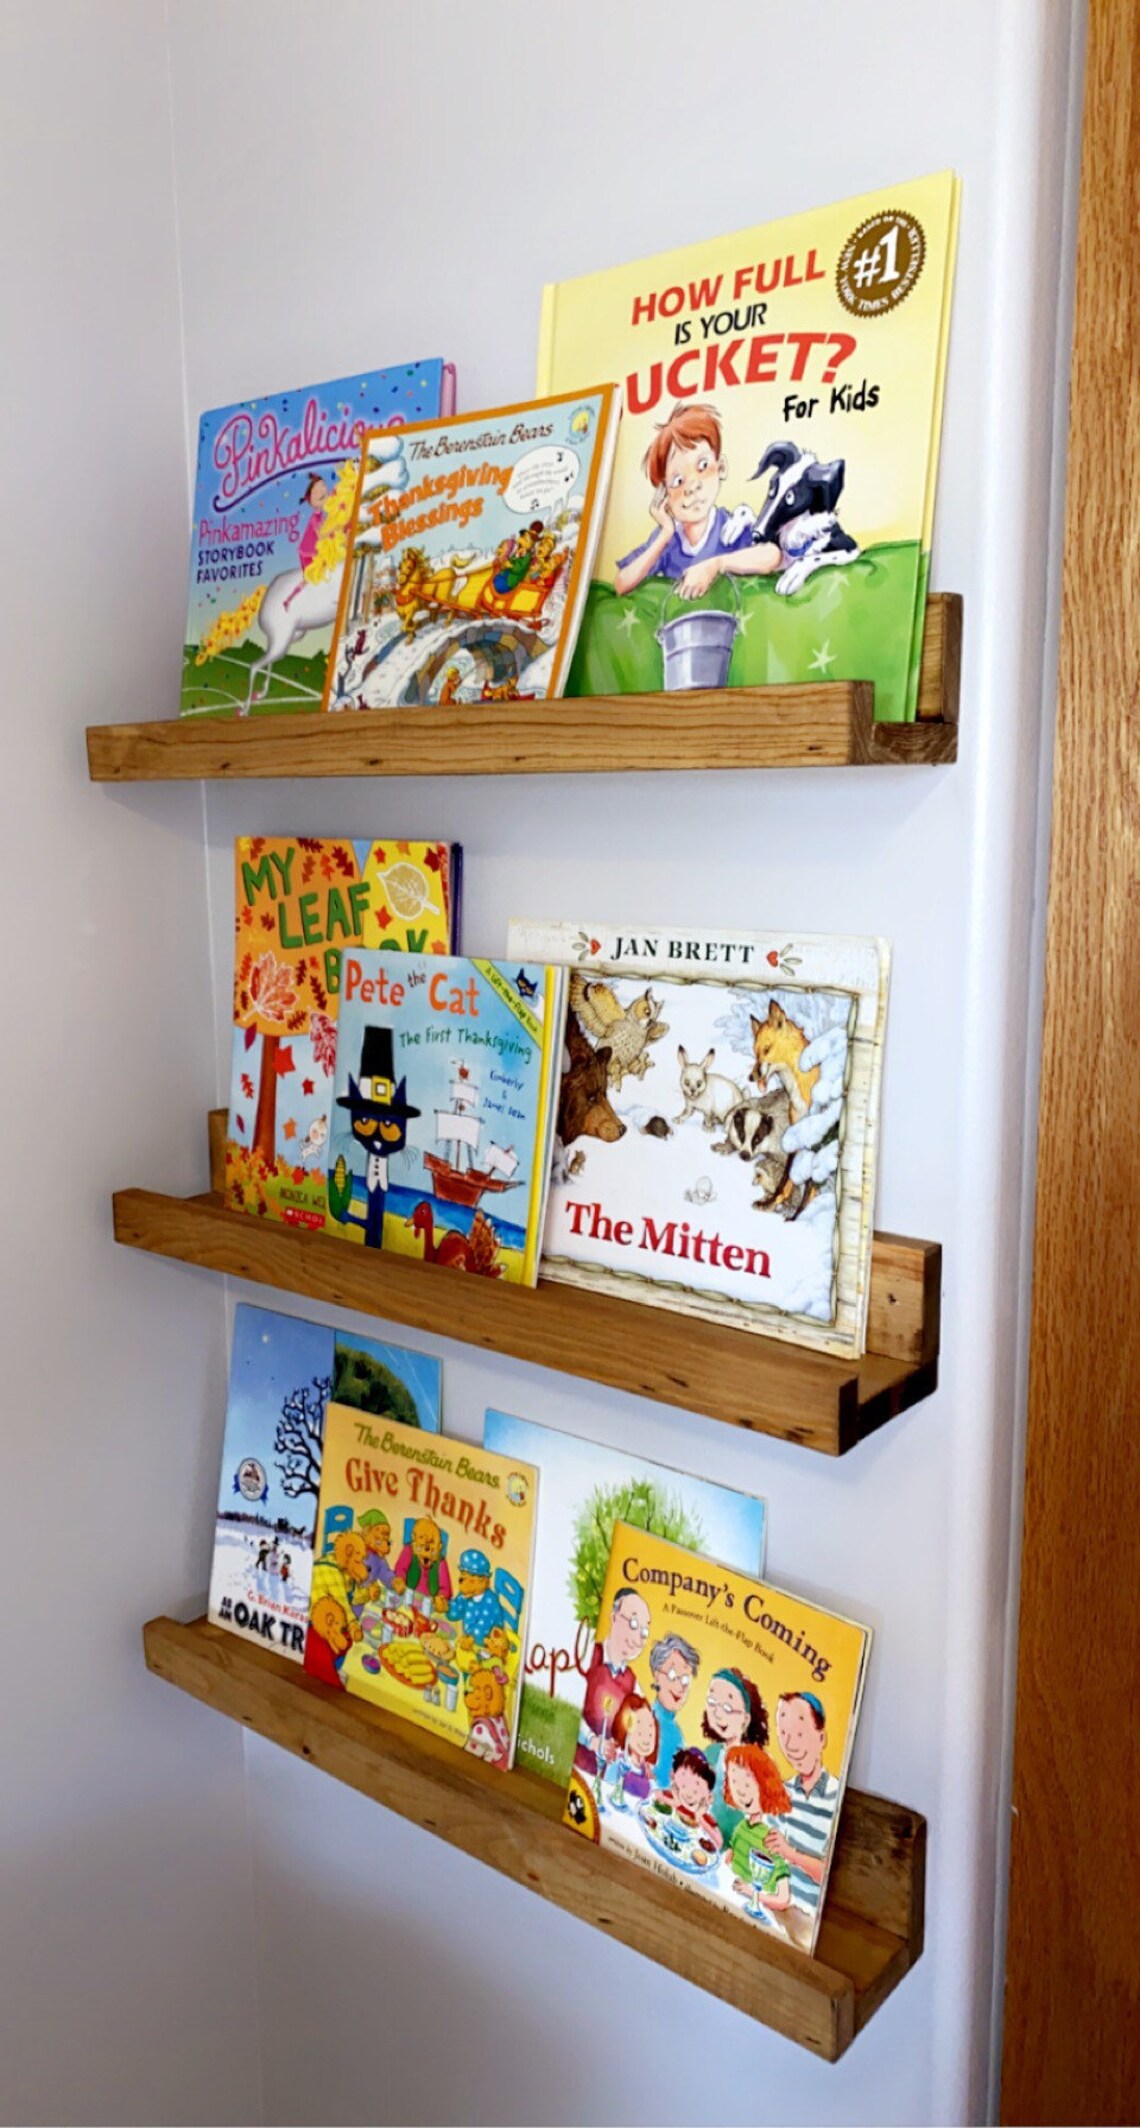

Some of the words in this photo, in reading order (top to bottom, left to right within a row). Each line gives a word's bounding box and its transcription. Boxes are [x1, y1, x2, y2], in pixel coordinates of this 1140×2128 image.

[853, 225, 900, 288] #1
[631, 274, 724, 326] HOW
[733, 249, 826, 301] FULL
[675, 320, 692, 345] IS
[700, 303, 768, 339] YOUR
[626, 332, 857, 415] UCKET?
[783, 394, 819, 423] For
[830, 378, 880, 414] Kids
[214, 398, 405, 498] Pinkalicio
[410, 440, 434, 462] The
[435, 431, 506, 459] Berenstain
[508, 422, 554, 444] Bears
[368, 462, 515, 526] Thanksgiving
[198, 511, 300, 546] Pinkamazing
[198, 541, 276, 566] STORYBOOK
[381, 497, 485, 552] Blessings
[196, 560, 262, 584] FAVORITES
[242, 847, 296, 906] MY
[278, 881, 371, 950] LEAF
[324, 928, 429, 995] BK
[610, 936, 658, 961] JAN
[668, 940, 755, 964] BRETT
[344, 958, 405, 1007] Pete
[407, 969, 426, 988] the
[429, 972, 480, 1017] Cat
[400, 1032, 420, 1048] The
[426, 1025, 452, 1044] First
[458, 1028, 532, 1065] Thanksgiving
[565, 1200, 633, 1246] The
[638, 1216, 772, 1279] Mitten
[354, 1422, 380, 1449] The
[380, 1432, 453, 1474] Berenstain
[456, 1457, 500, 1489] Bears
[345, 1457, 398, 1496] Give
[406, 1467, 507, 1550] Thanks
[234, 1602, 277, 1641] OAK
[280, 1620, 305, 1654] TR
[622, 1557, 736, 1609] Company's
[743, 1594, 833, 1682] Coming
[662, 1602, 670, 1612] A
[525, 1616, 589, 1699] apl
[518, 1733, 554, 1765] ichols
